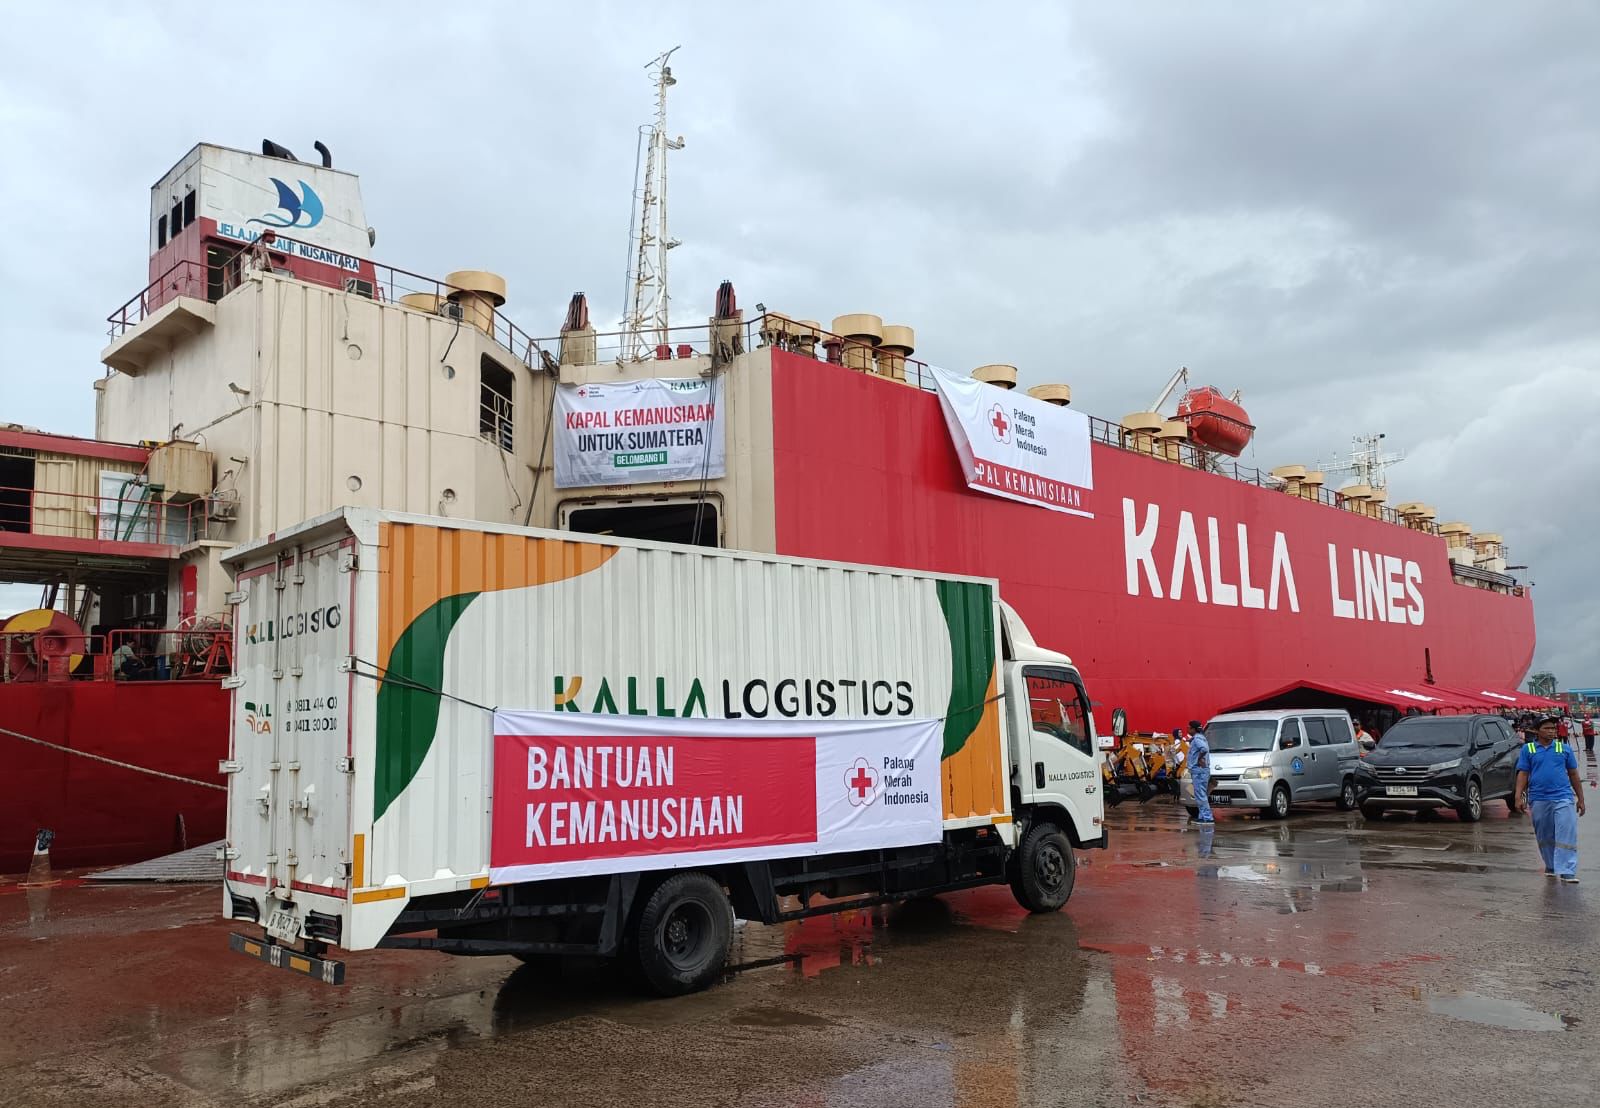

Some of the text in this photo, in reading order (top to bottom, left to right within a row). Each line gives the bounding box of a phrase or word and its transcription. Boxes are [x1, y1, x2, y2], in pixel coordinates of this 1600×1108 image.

[217, 222, 261, 243] JELAJA
[299, 245, 360, 271] NUSANTARA
[566, 404, 715, 429] KAPAL KEMANUSIAAN
[1014, 408, 1036, 426] Palang
[578, 427, 704, 452] UNTUK SUMATERA
[1015, 423, 1035, 439] Merah
[1016, 438, 1047, 456] Indonesia
[616, 454, 658, 465] GELOMBANG
[975, 463, 1081, 507] PAL KEMANUSIAAN
[1122, 497, 1425, 626] KALLA LINES
[554, 676, 914, 719] KALLA LOGISTICS
[526, 746, 675, 791] BANTUAN
[884, 757, 915, 771] Palang
[884, 774, 912, 788] Merah
[1068, 770, 1095, 781] LOGISTICS
[884, 791, 929, 805] Indonesia
[525, 795, 744, 848] KEMANUSIAAN
